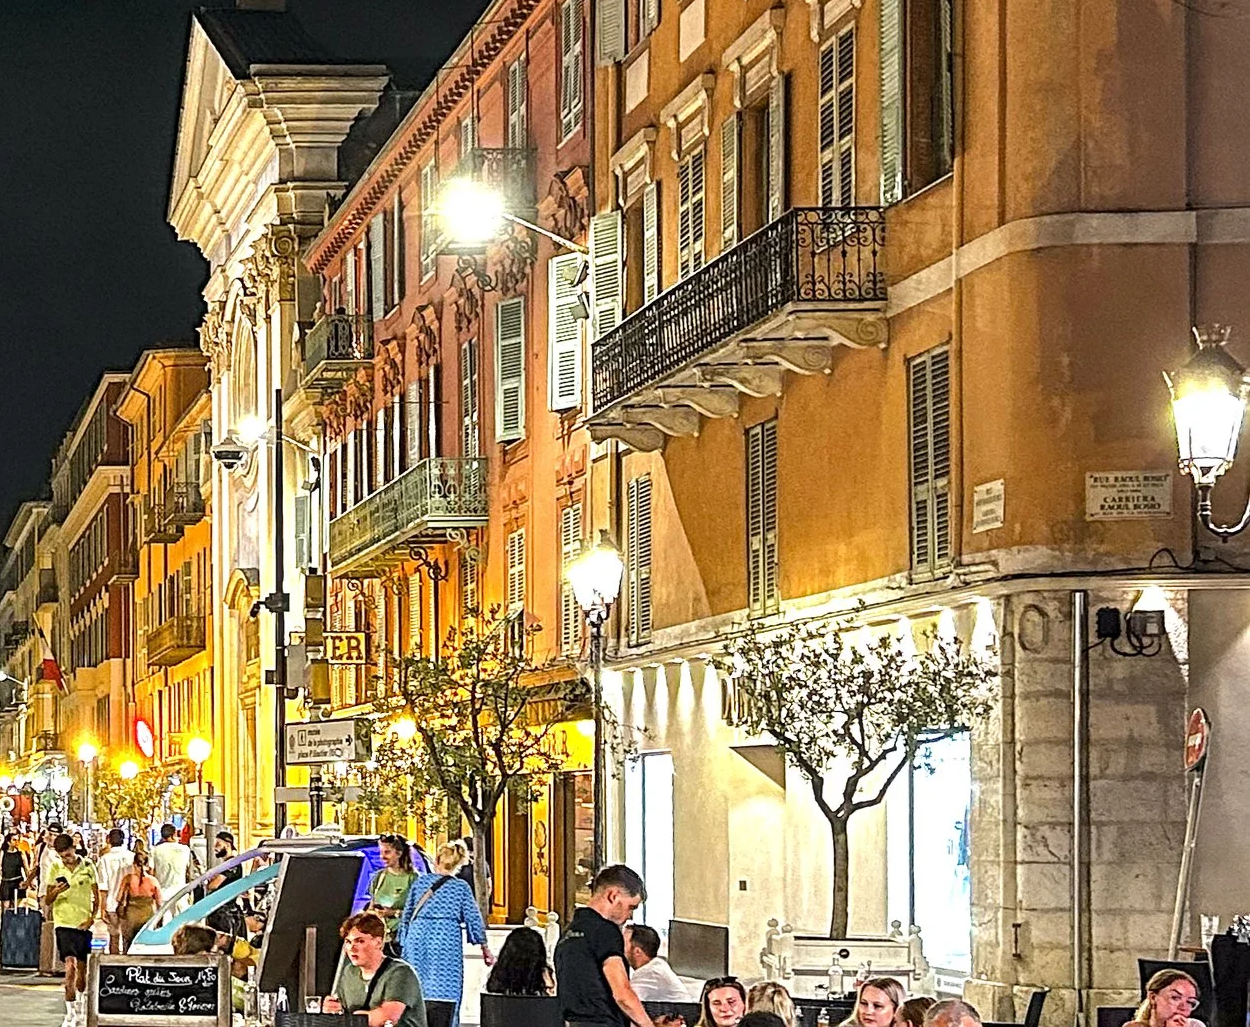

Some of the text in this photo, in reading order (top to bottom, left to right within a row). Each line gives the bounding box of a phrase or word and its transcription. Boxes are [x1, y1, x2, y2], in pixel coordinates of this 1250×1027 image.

[1093, 476, 1110, 484] RUE
[1113, 475, 1141, 483] RAOUL
[1103, 495, 1156, 503] CARRIERA
[1099, 503, 1131, 511] RAOUL
[126, 966, 151, 984] Plat
[153, 972, 165, 983] du
[168, 971, 192, 984] Jour
